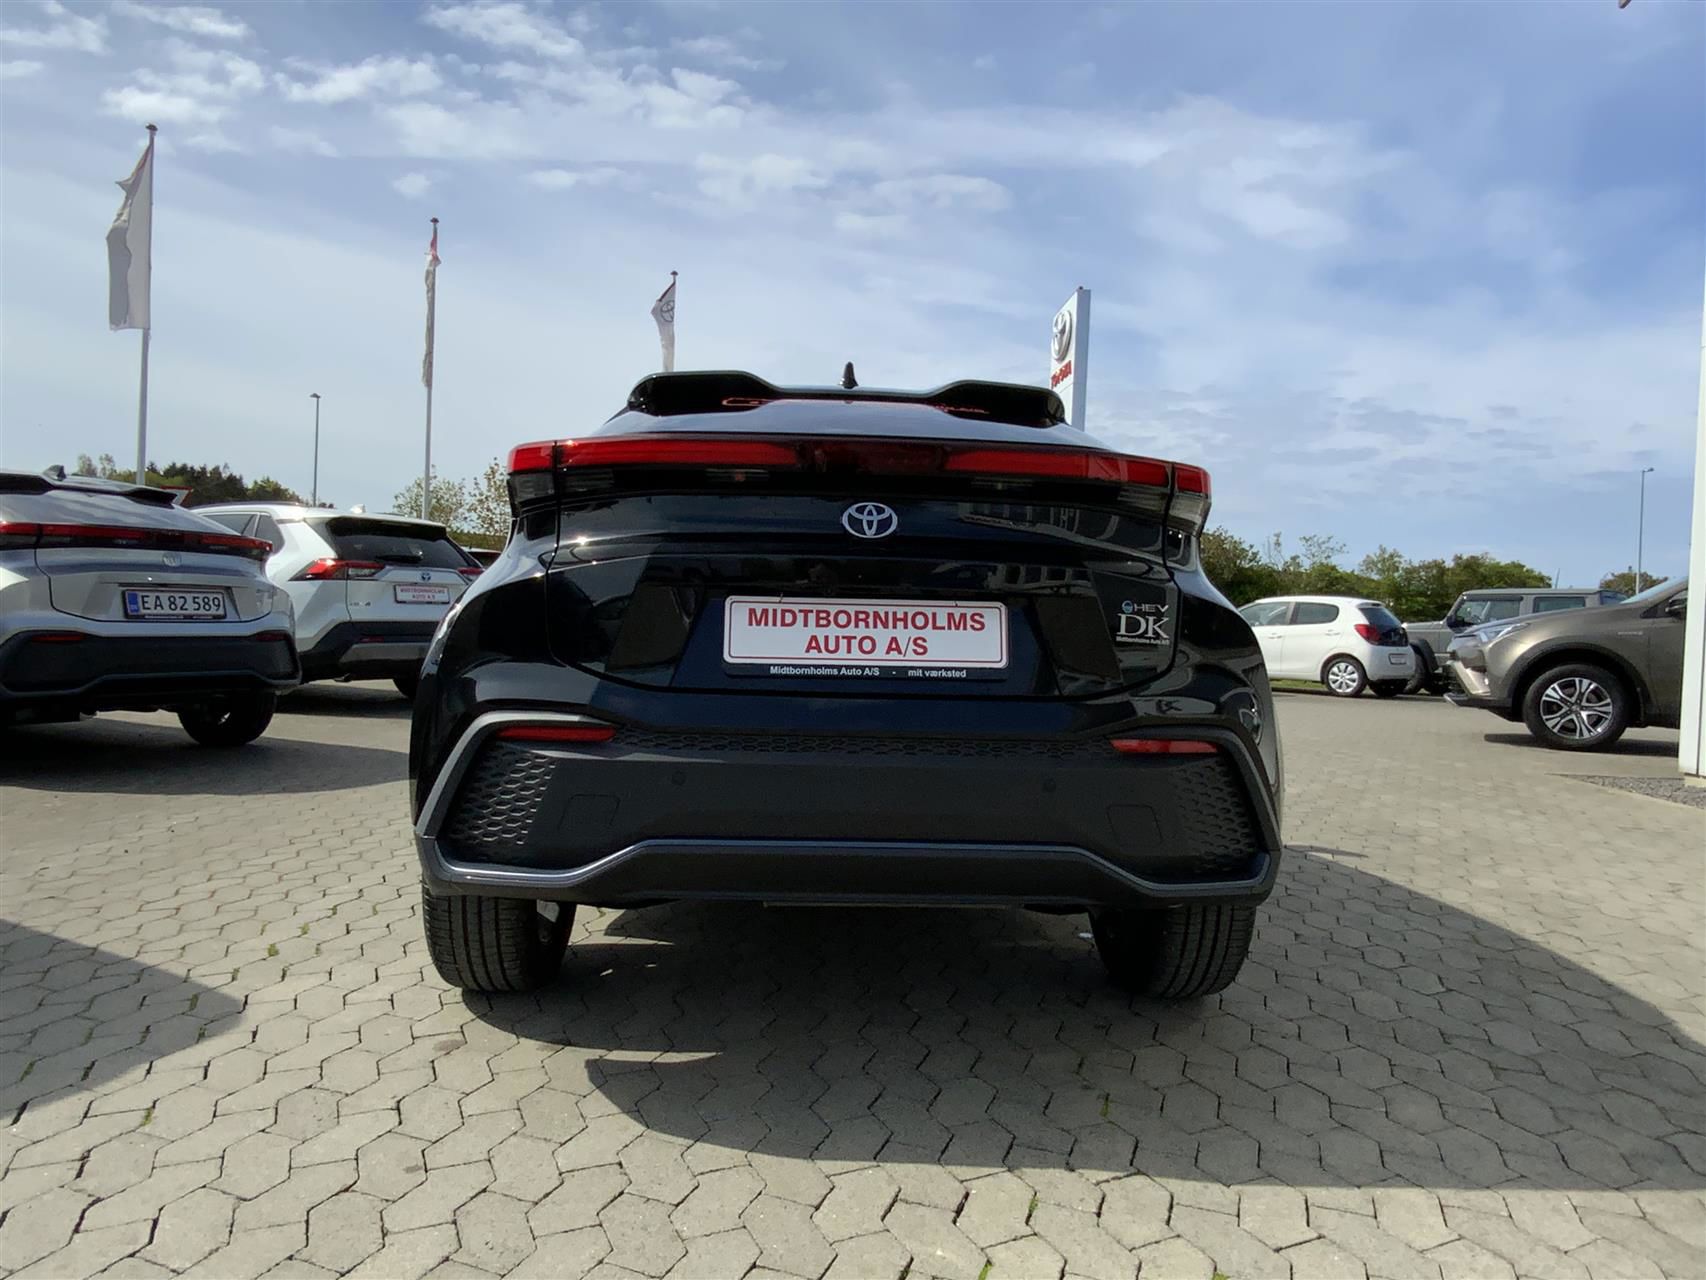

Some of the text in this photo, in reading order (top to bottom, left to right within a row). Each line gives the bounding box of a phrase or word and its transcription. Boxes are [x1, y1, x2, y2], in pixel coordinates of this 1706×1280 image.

[141, 594, 165, 611] EA
[168, 595, 189, 612] 82
[192, 596, 221, 612] 589
[1134, 603, 1169, 613] HEV
[747, 607, 986, 632] MIDTBORNHOLMS
[1116, 613, 1170, 639] DK
[804, 634, 928, 658] AUTO A/S
[769, 665, 839, 675] Midtbornholms
[840, 667, 862, 676] Auto
[863, 667, 880, 676] A/S
[907, 668, 923, 677] mit
[924, 669, 967, 678] værksted
